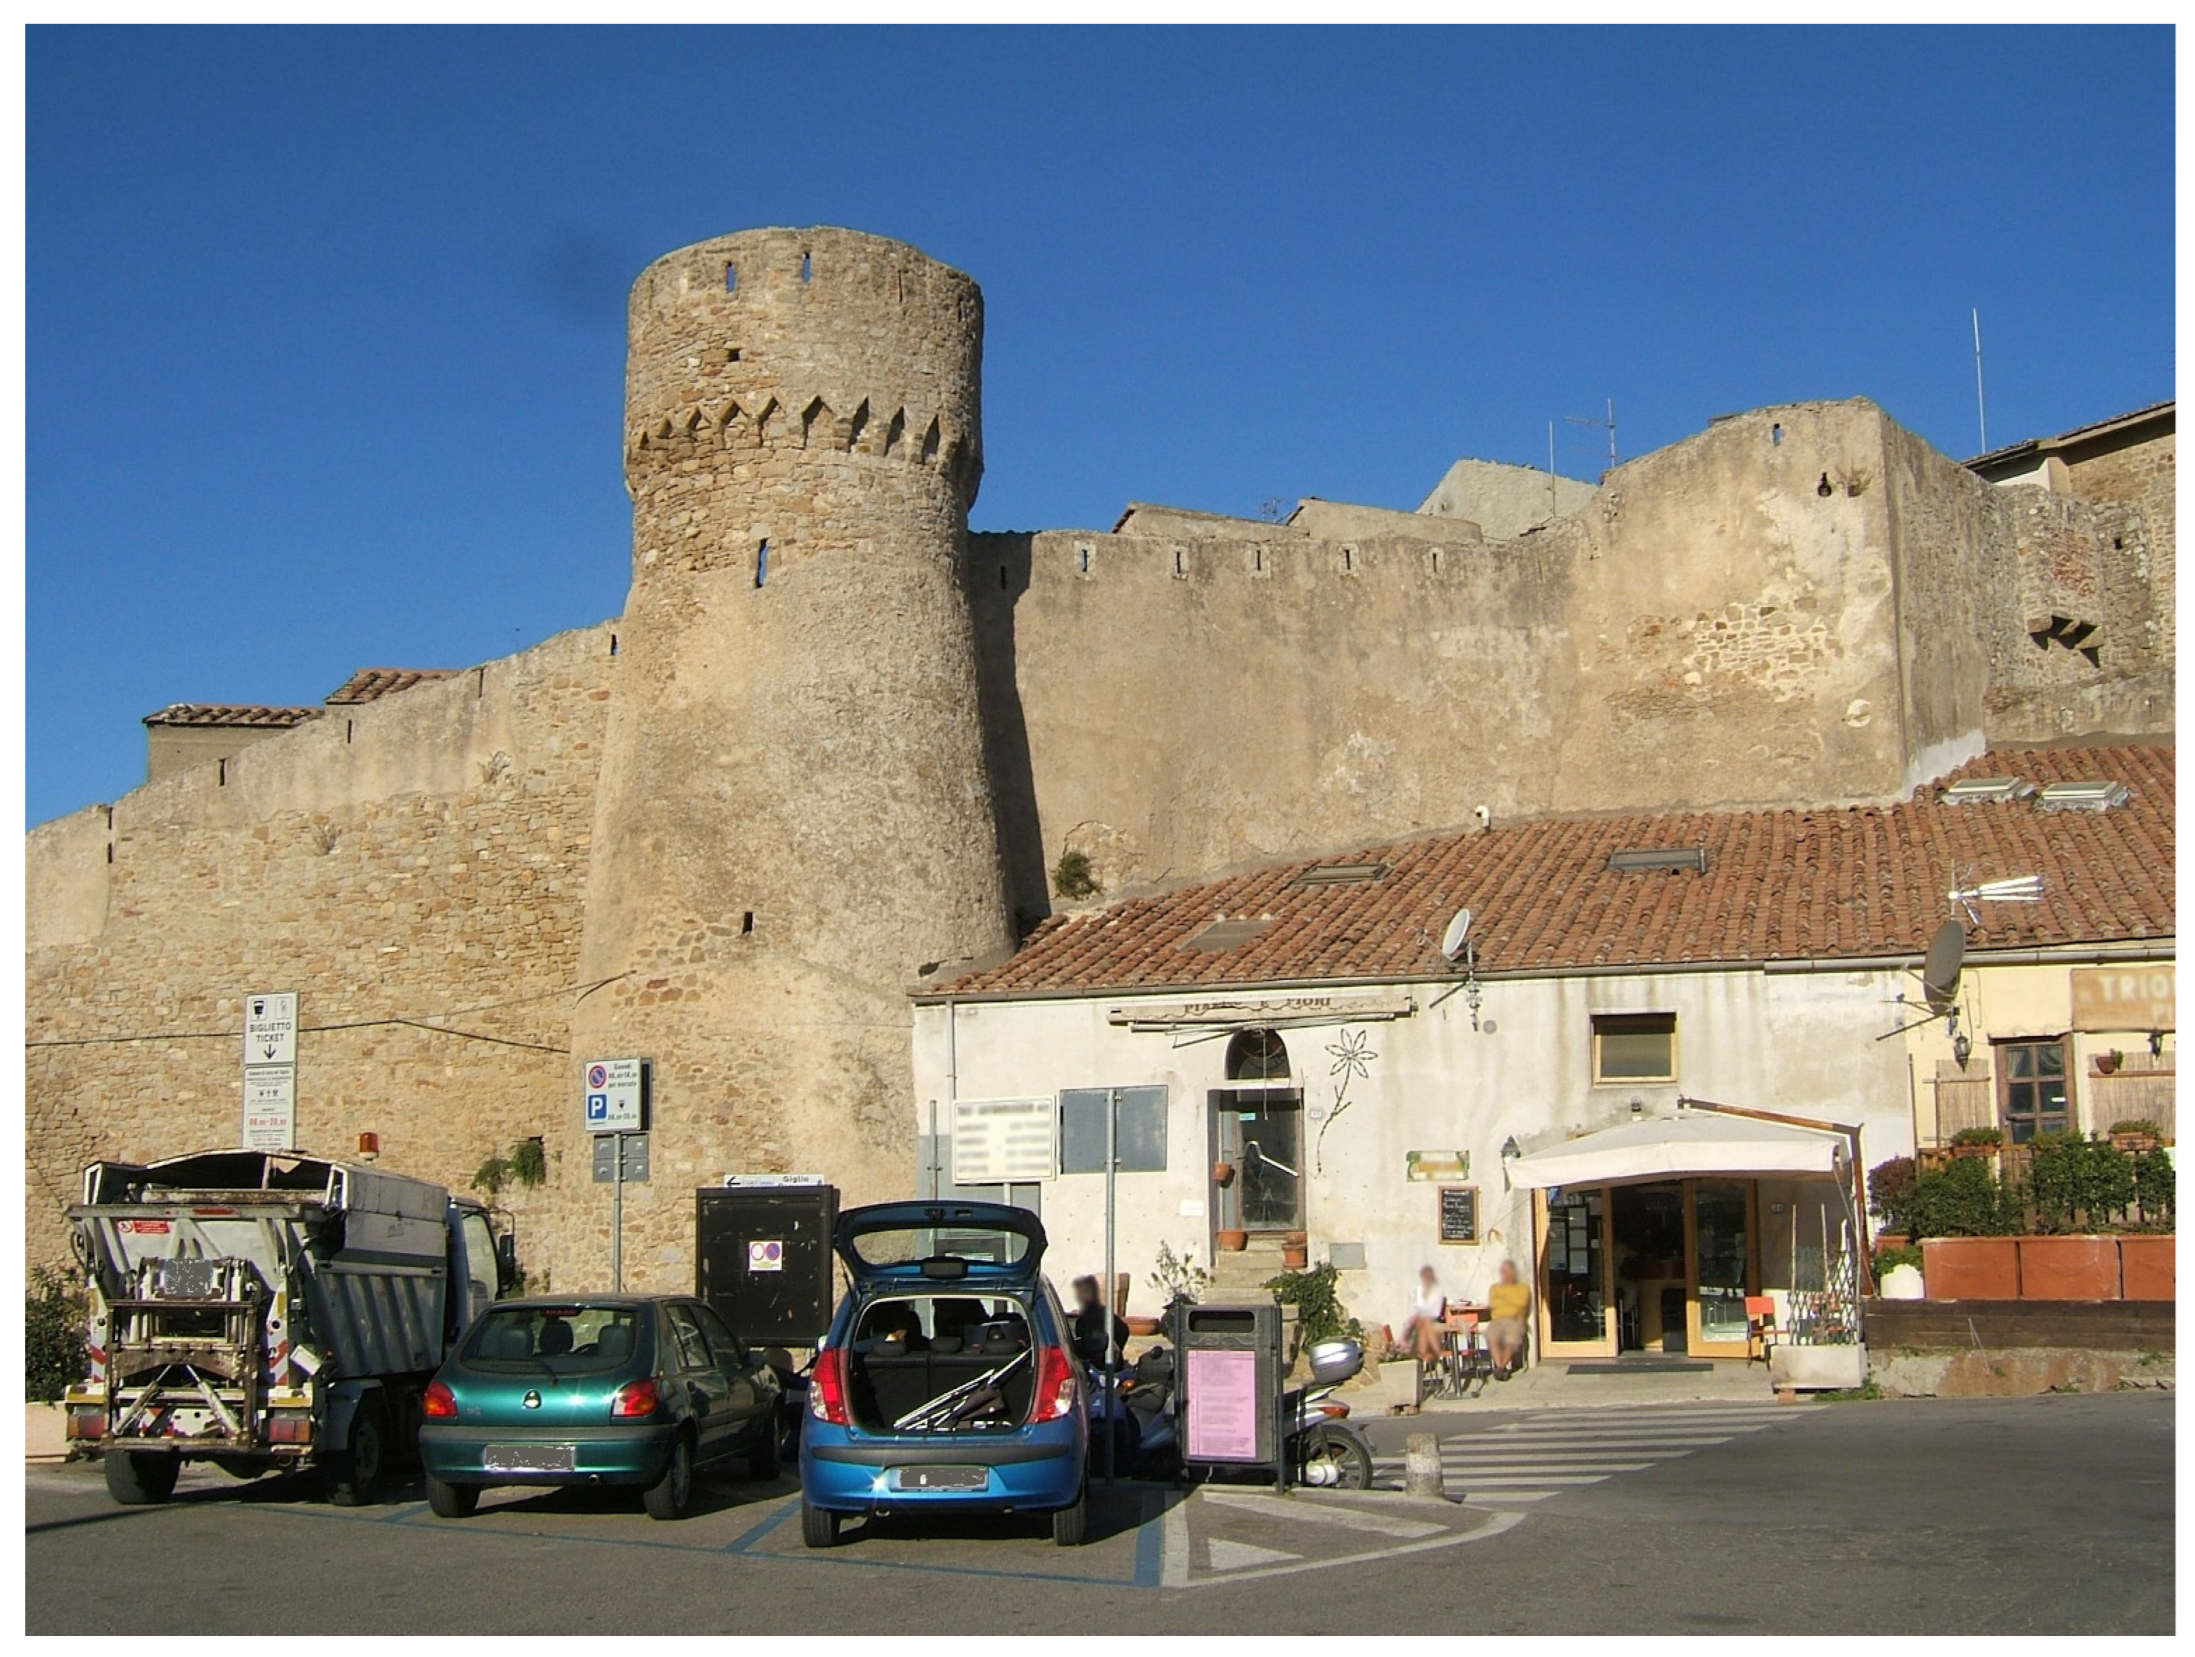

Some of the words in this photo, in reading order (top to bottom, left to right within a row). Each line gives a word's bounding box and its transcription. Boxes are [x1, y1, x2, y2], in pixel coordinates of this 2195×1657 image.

[249, 1021, 291, 1033] BIGLIETTO
[256, 1032, 285, 1043] TICKET
[590, 1097, 604, 1118] P
[782, 1175, 809, 1184] Giglio
